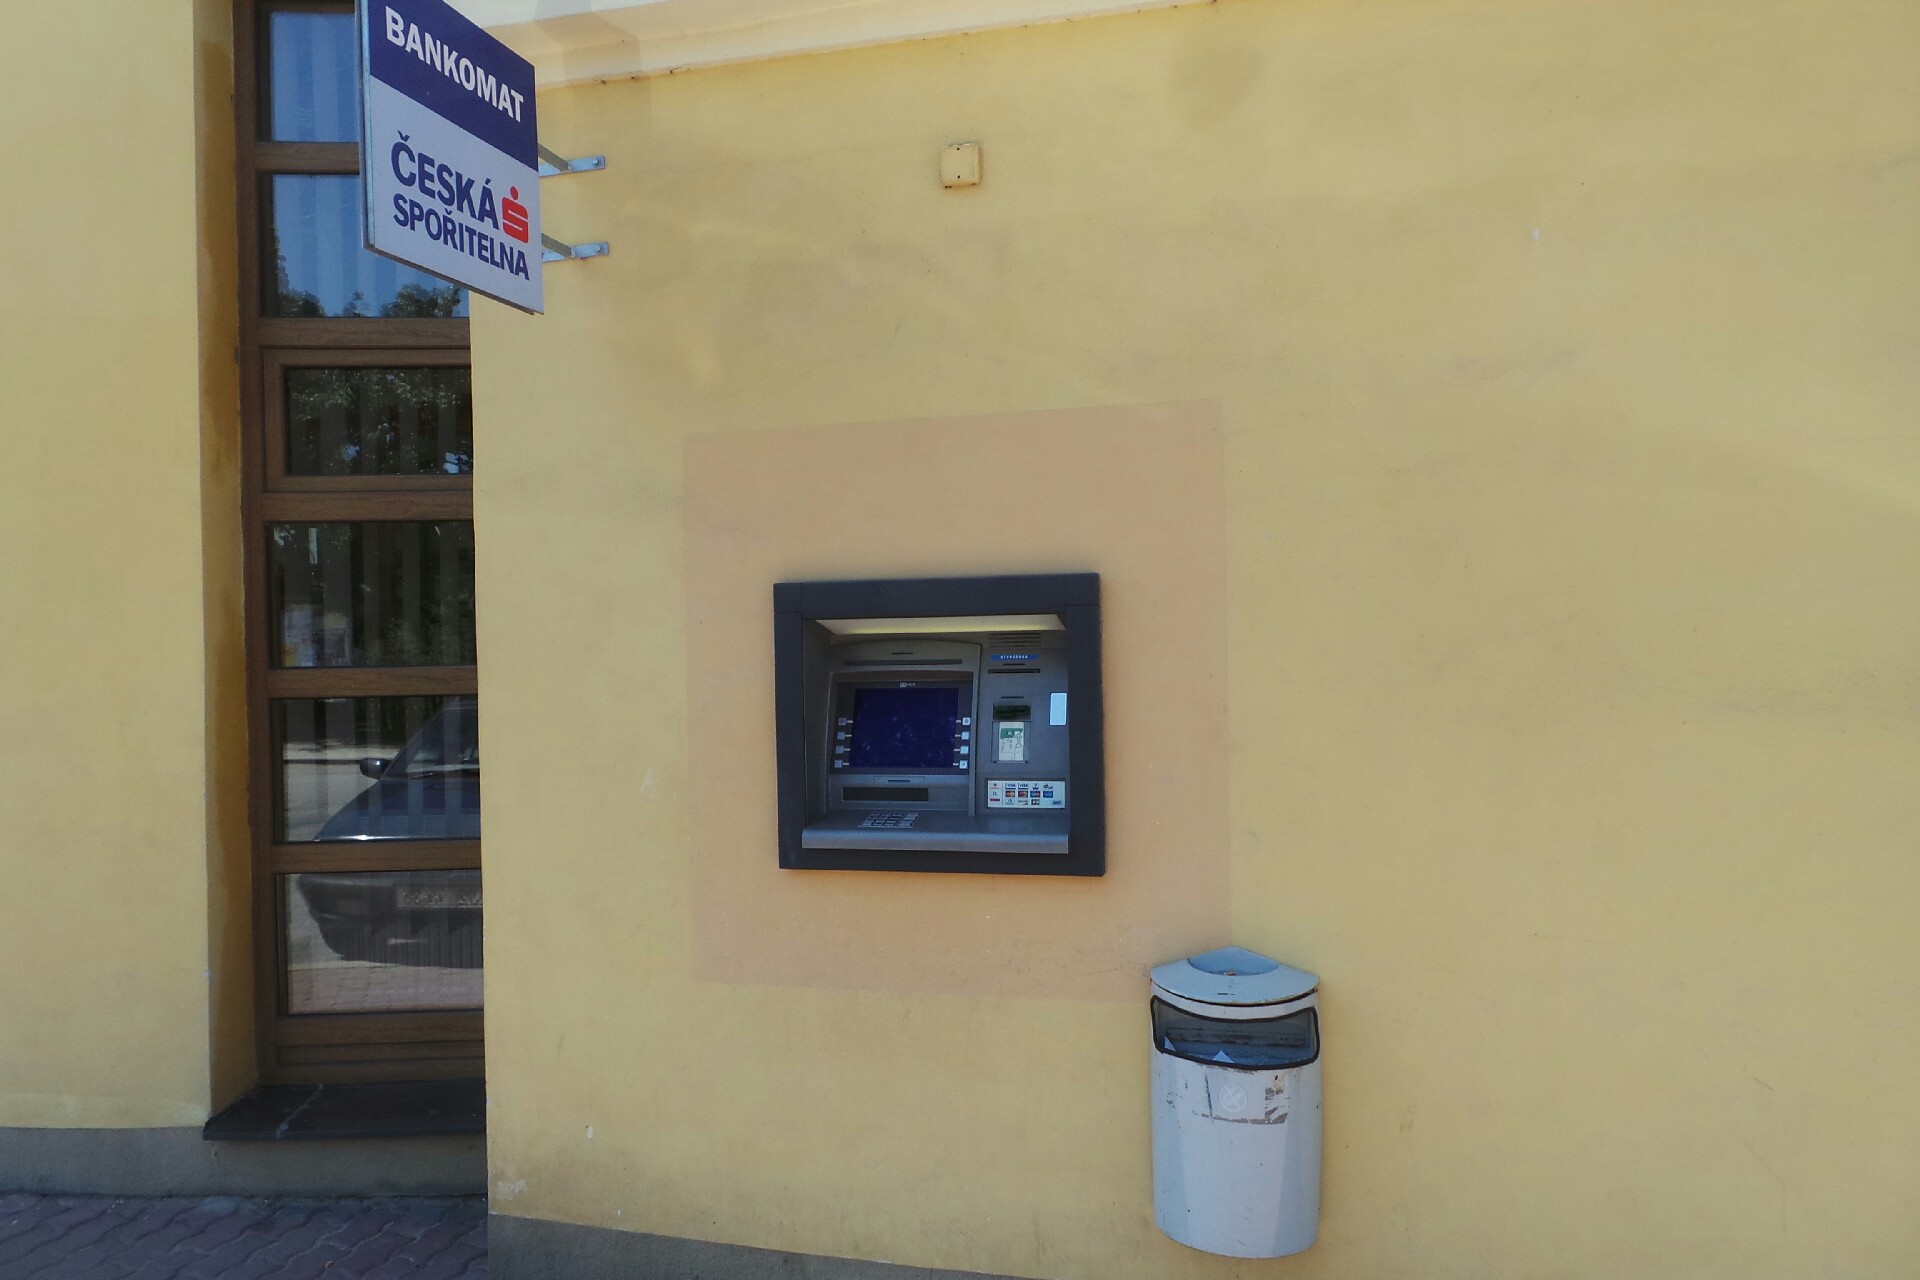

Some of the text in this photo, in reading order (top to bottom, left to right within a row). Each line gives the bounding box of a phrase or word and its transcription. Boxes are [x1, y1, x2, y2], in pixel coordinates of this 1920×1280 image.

[385, 6, 524, 123] BANKOMAT
[391, 130, 500, 231] ČESKÁ
[393, 192, 530, 281] SPOŘITELNA
